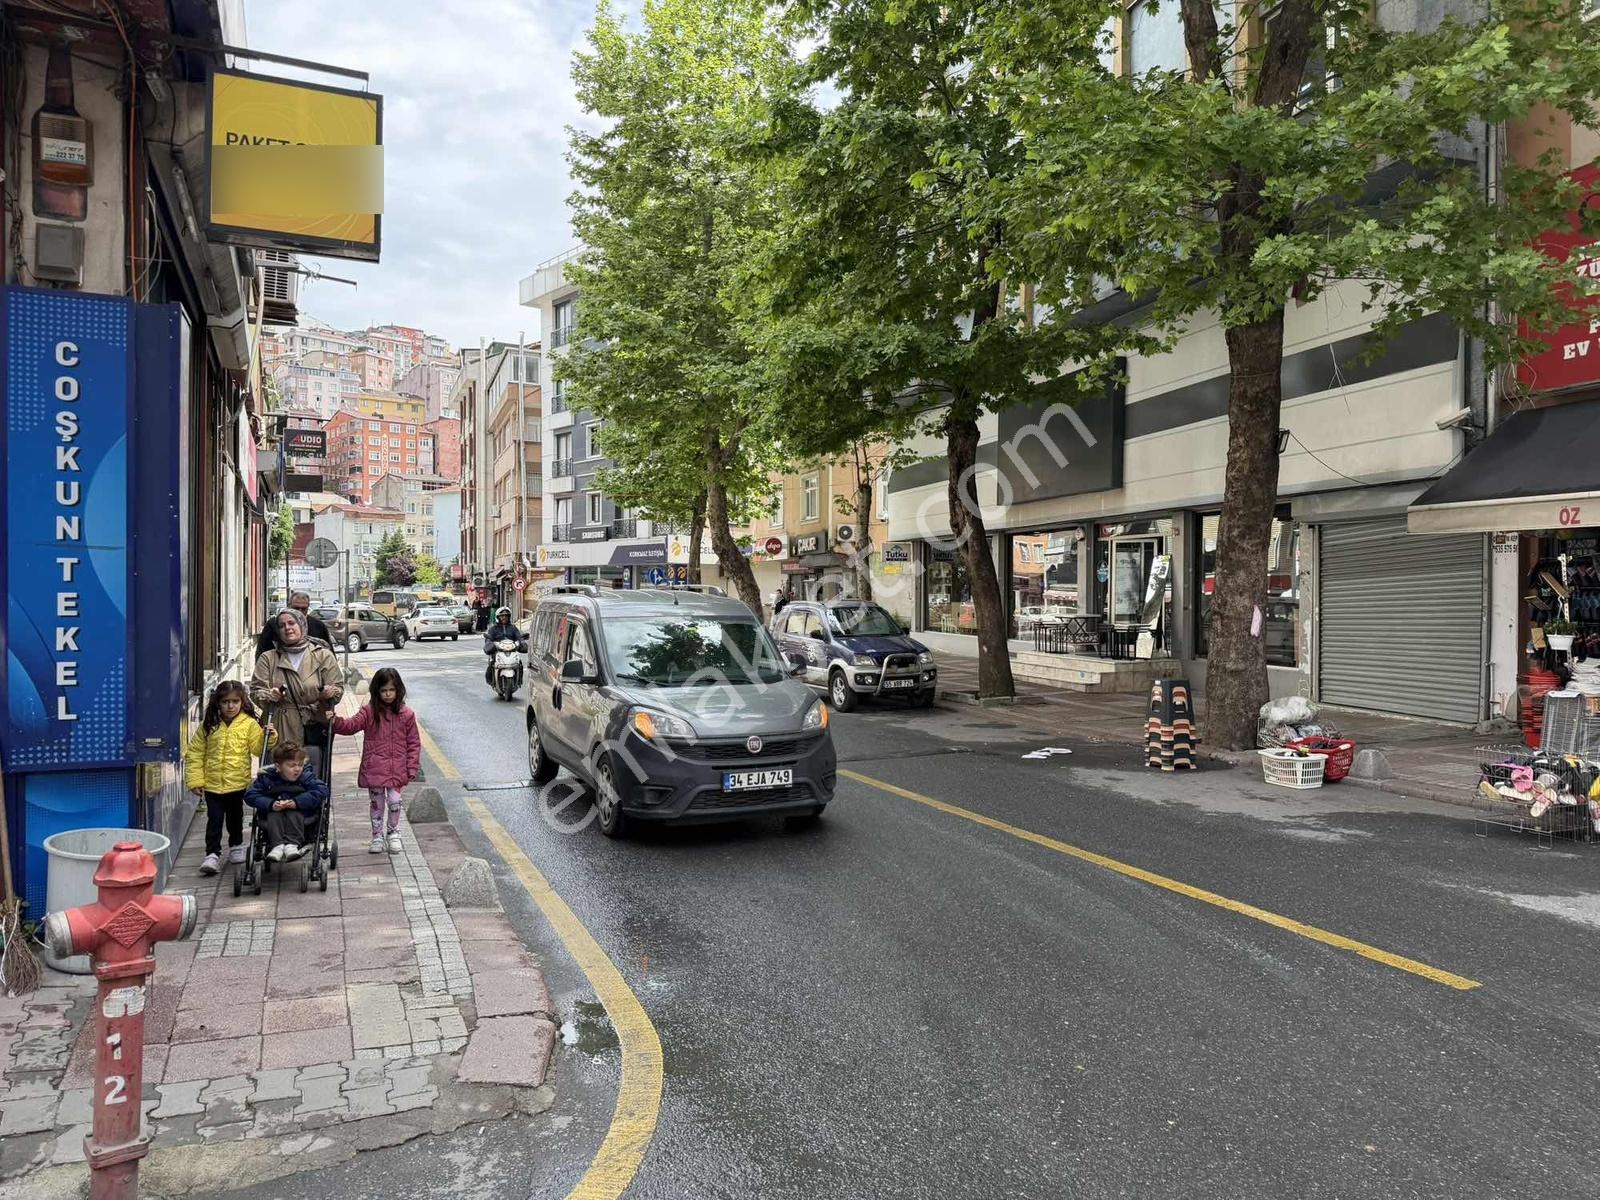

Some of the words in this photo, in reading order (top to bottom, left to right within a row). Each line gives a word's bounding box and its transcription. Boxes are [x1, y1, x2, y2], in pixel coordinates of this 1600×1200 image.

[1563, 340, 1590, 360] EV
[55, 340, 80, 541] COŞKUN
[291, 435, 322, 444] AUDIO
[1559, 505, 1581, 525] ÖZ
[546, 551, 570, 559] TURKCELL
[56, 556, 79, 721] TEKEL
[730, 774, 743, 787] 34
[747, 772, 767, 785] EJA
[770, 770, 790, 784] 749
